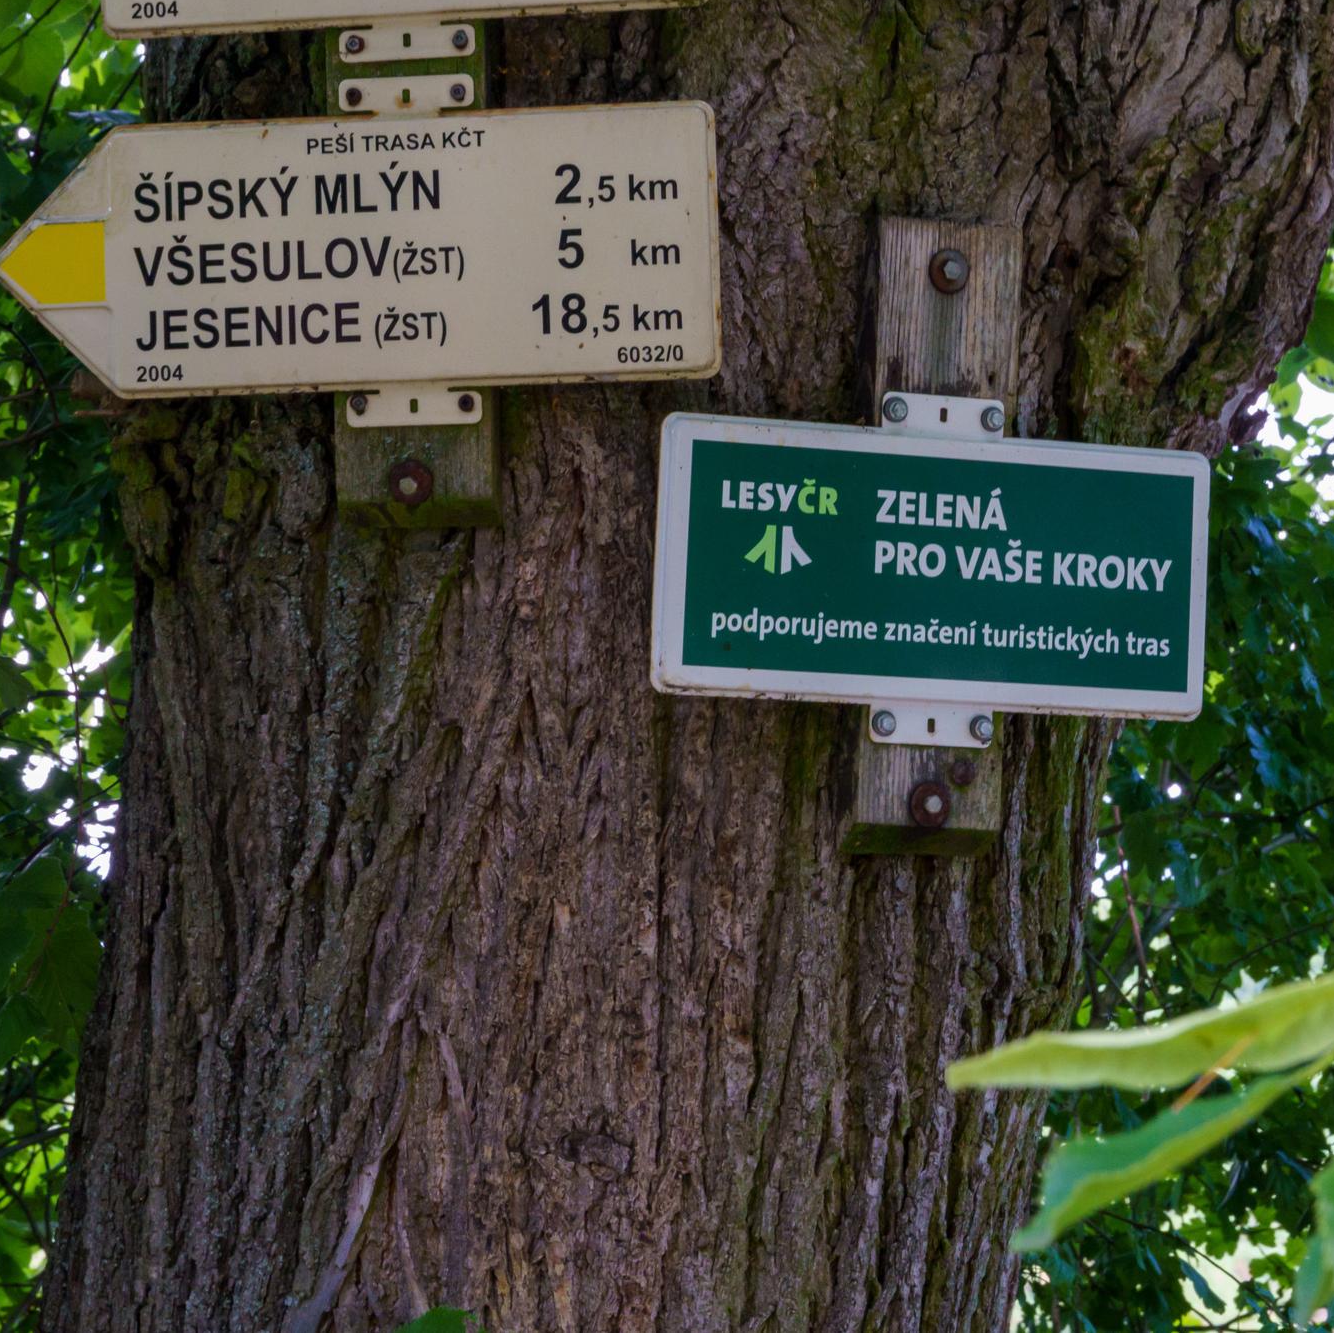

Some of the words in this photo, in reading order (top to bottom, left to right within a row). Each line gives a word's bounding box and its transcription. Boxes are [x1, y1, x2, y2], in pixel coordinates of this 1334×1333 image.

[131, 0, 179, 20] 2004
[360, 132, 436, 153] TRASA
[442, 127, 486, 149] KČT
[133, 165, 299, 224] ŠÍPSKÝ
[314, 160, 441, 216] MLÝN
[554, 163, 616, 209] 2,5
[628, 173, 679, 202] km
[557, 227, 585, 270] 5
[630, 238, 681, 267] km
[135, 301, 362, 352] JESENICE
[374, 306, 447, 350] (ŽST)
[531, 292, 621, 339] 18,5
[632, 303, 683, 332] km
[136, 363, 184, 383] 2004
[617, 344, 684, 364] 6032/0
[876, 487, 1007, 531] ZELENÁ
[874, 540, 946, 578] PRO
[955, 538, 1043, 584] VAŠE
[1052, 552, 1173, 592] KROKY
[711, 607, 878, 644] podporujeme
[884, 618, 977, 646] značení
[981, 623, 1119, 660] turistických
[1125, 631, 1170, 657] tras
